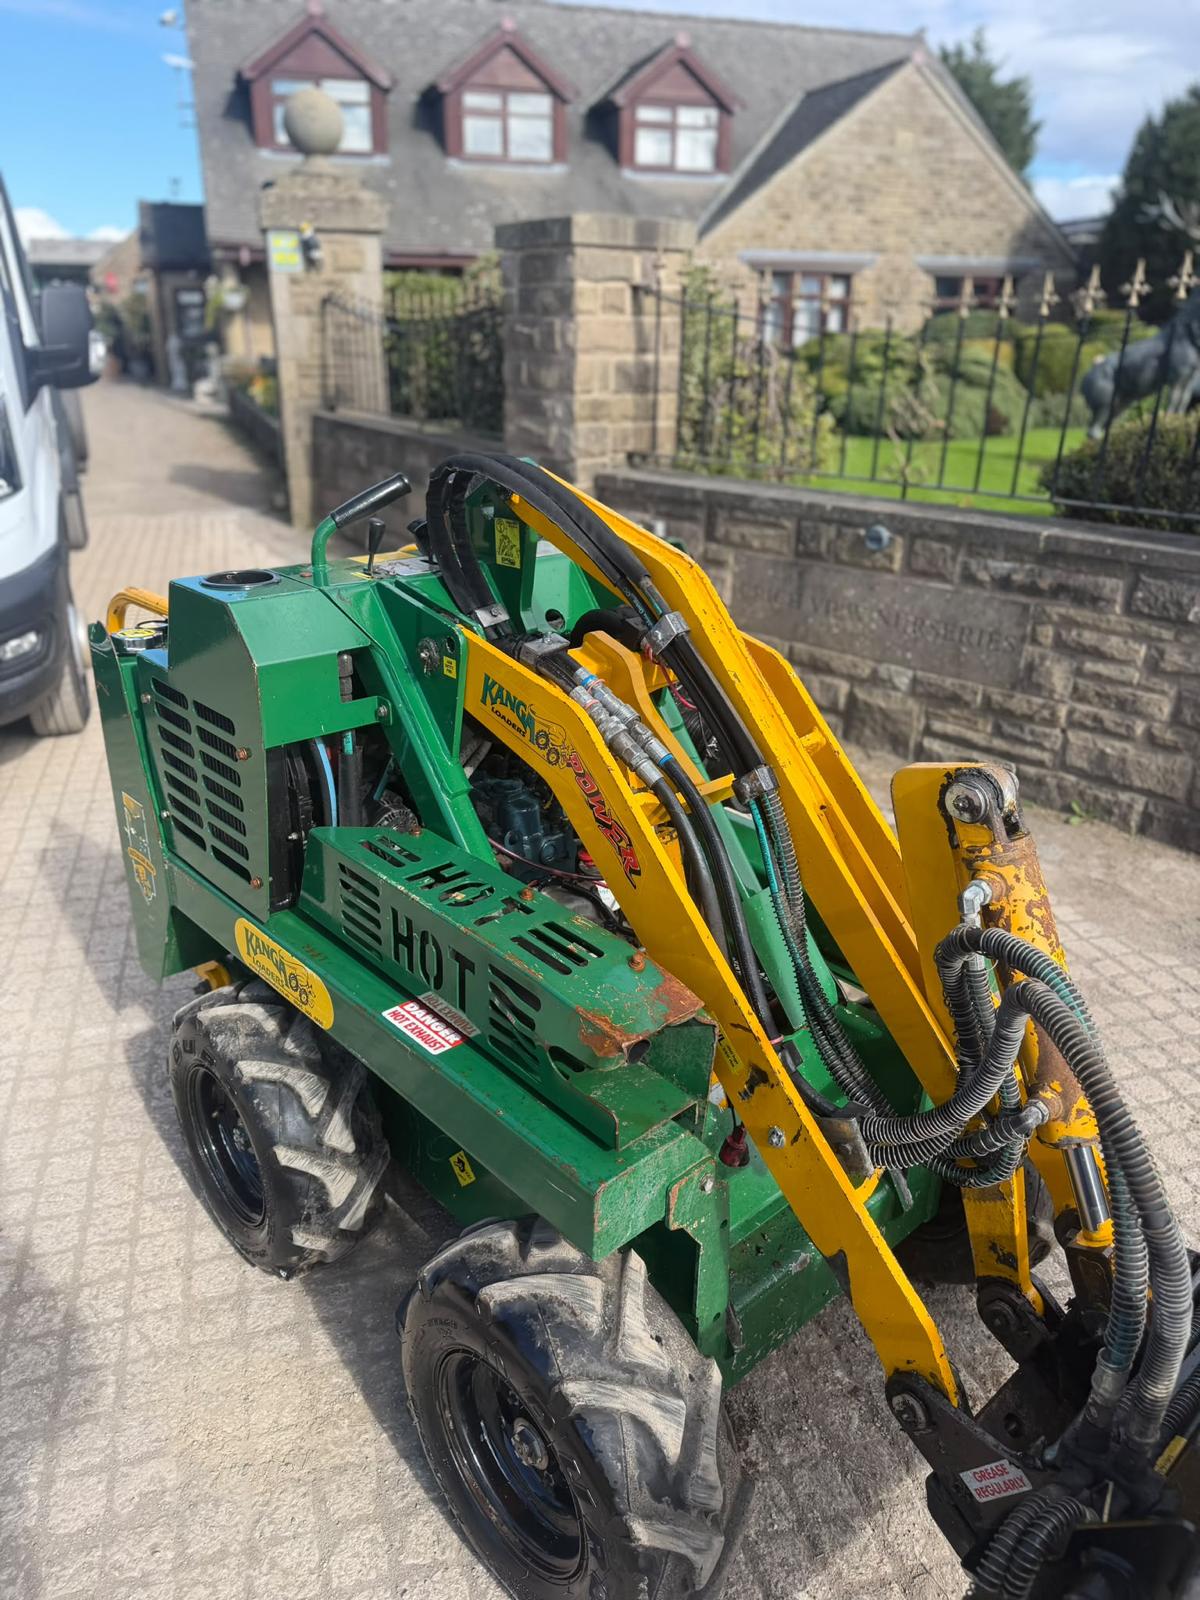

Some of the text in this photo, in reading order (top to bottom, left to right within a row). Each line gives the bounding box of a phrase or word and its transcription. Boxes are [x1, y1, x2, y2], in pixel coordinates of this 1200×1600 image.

[480, 673, 536, 744] KANGA
[491, 706, 526, 738] LOADERS
[567, 752, 642, 888] POWER
[405, 861, 535, 927] HOT
[244, 927, 290, 989] KANGA
[252, 956, 285, 990] LOADERS
[390, 905, 476, 1014] HOT
[387, 1009, 446, 1051] HOT EXHAUST
[402, 1001, 463, 1044] DANGER
[973, 1463, 1009, 1482] GREASE
[975, 1475, 1025, 1499] REGULARLY
